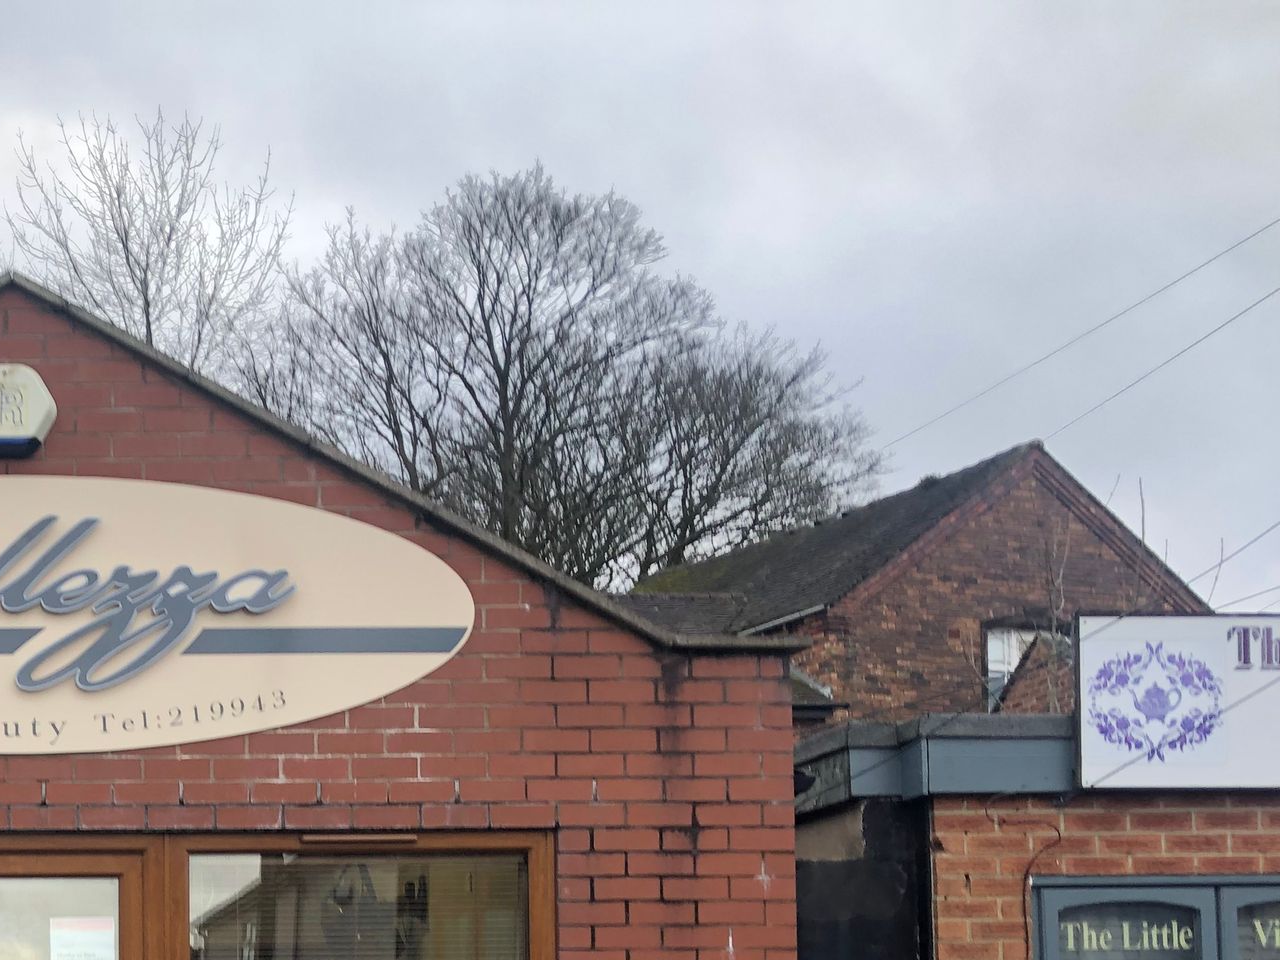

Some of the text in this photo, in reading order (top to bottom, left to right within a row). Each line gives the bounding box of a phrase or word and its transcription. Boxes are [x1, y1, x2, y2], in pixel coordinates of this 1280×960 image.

[1226, 626, 1280, 670] Th
[1060, 918, 1280, 951] The Little Vi
